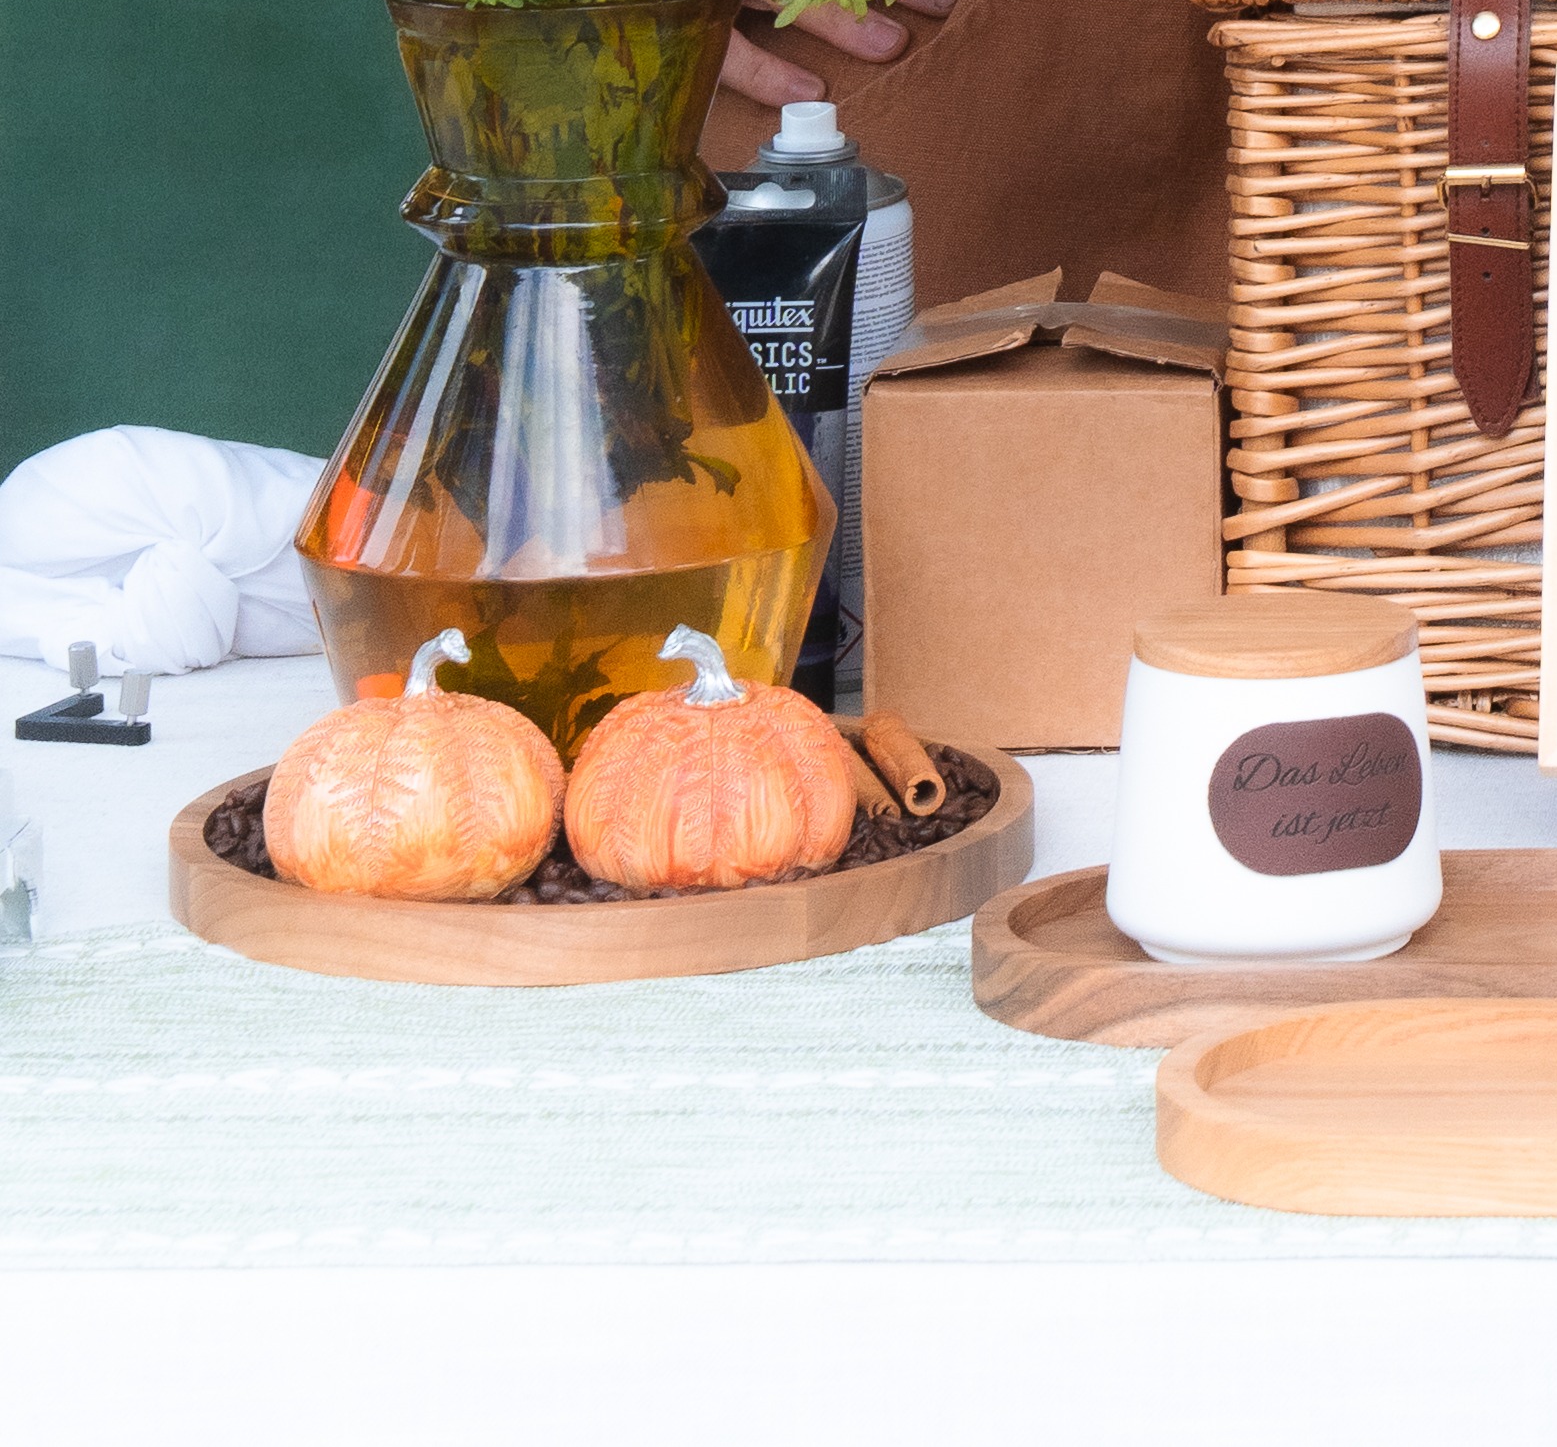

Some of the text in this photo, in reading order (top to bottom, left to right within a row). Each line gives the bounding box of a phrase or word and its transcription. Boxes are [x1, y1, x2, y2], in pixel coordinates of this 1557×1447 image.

[725, 296, 815, 334] quitex
[764, 372, 811, 395] LIC
[1232, 753, 1323, 792] Das
[1271, 802, 1391, 845] ist jetzt
